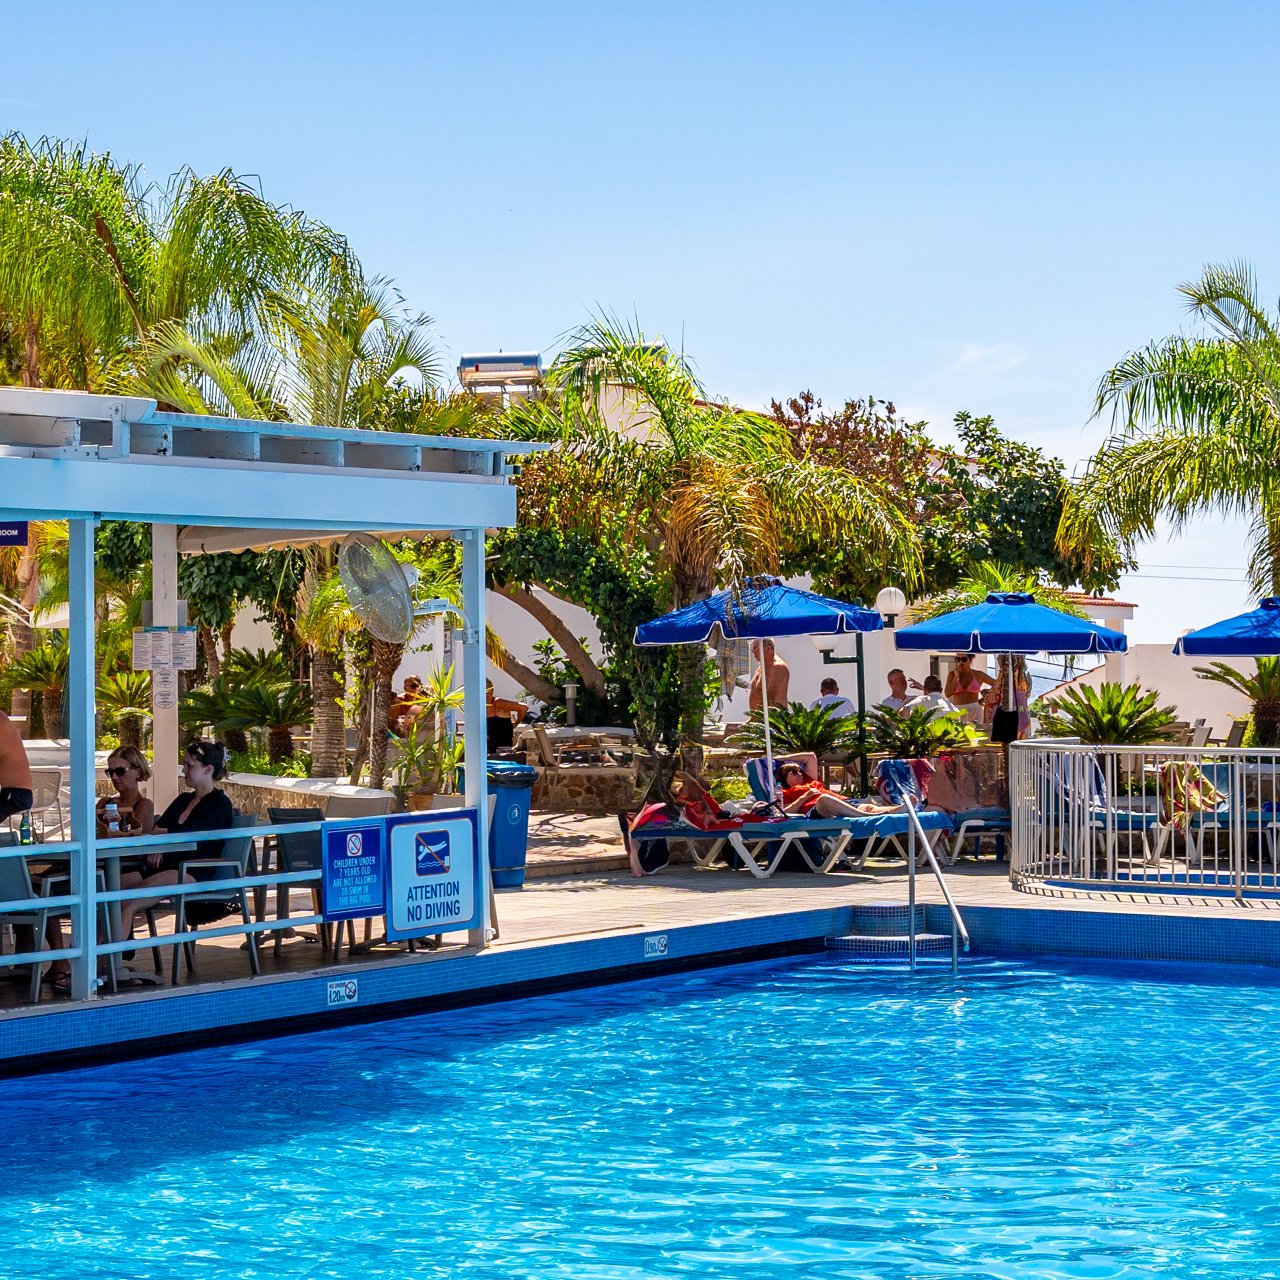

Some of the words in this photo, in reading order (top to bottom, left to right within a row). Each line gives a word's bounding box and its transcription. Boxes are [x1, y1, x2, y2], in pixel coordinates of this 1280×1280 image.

[334, 858, 358, 868] CHILDREN
[359, 856, 376, 866] UNDER
[339, 869, 342, 877] 7
[344, 867, 360, 877] YEARS
[361, 866, 370, 875] OLD
[333, 879, 342, 888] ARE
[344, 877, 354, 887] NOT
[355, 875, 377, 885] ALLOWED
[341, 887, 348, 896] TO
[349, 886, 362, 896] SWIM
[363, 885, 368, 894] IN
[407, 881, 460, 902] ATTENTION
[339, 896, 348, 906] THE
[407, 904, 422, 922] NO
[426, 900, 460, 920] DIVING
